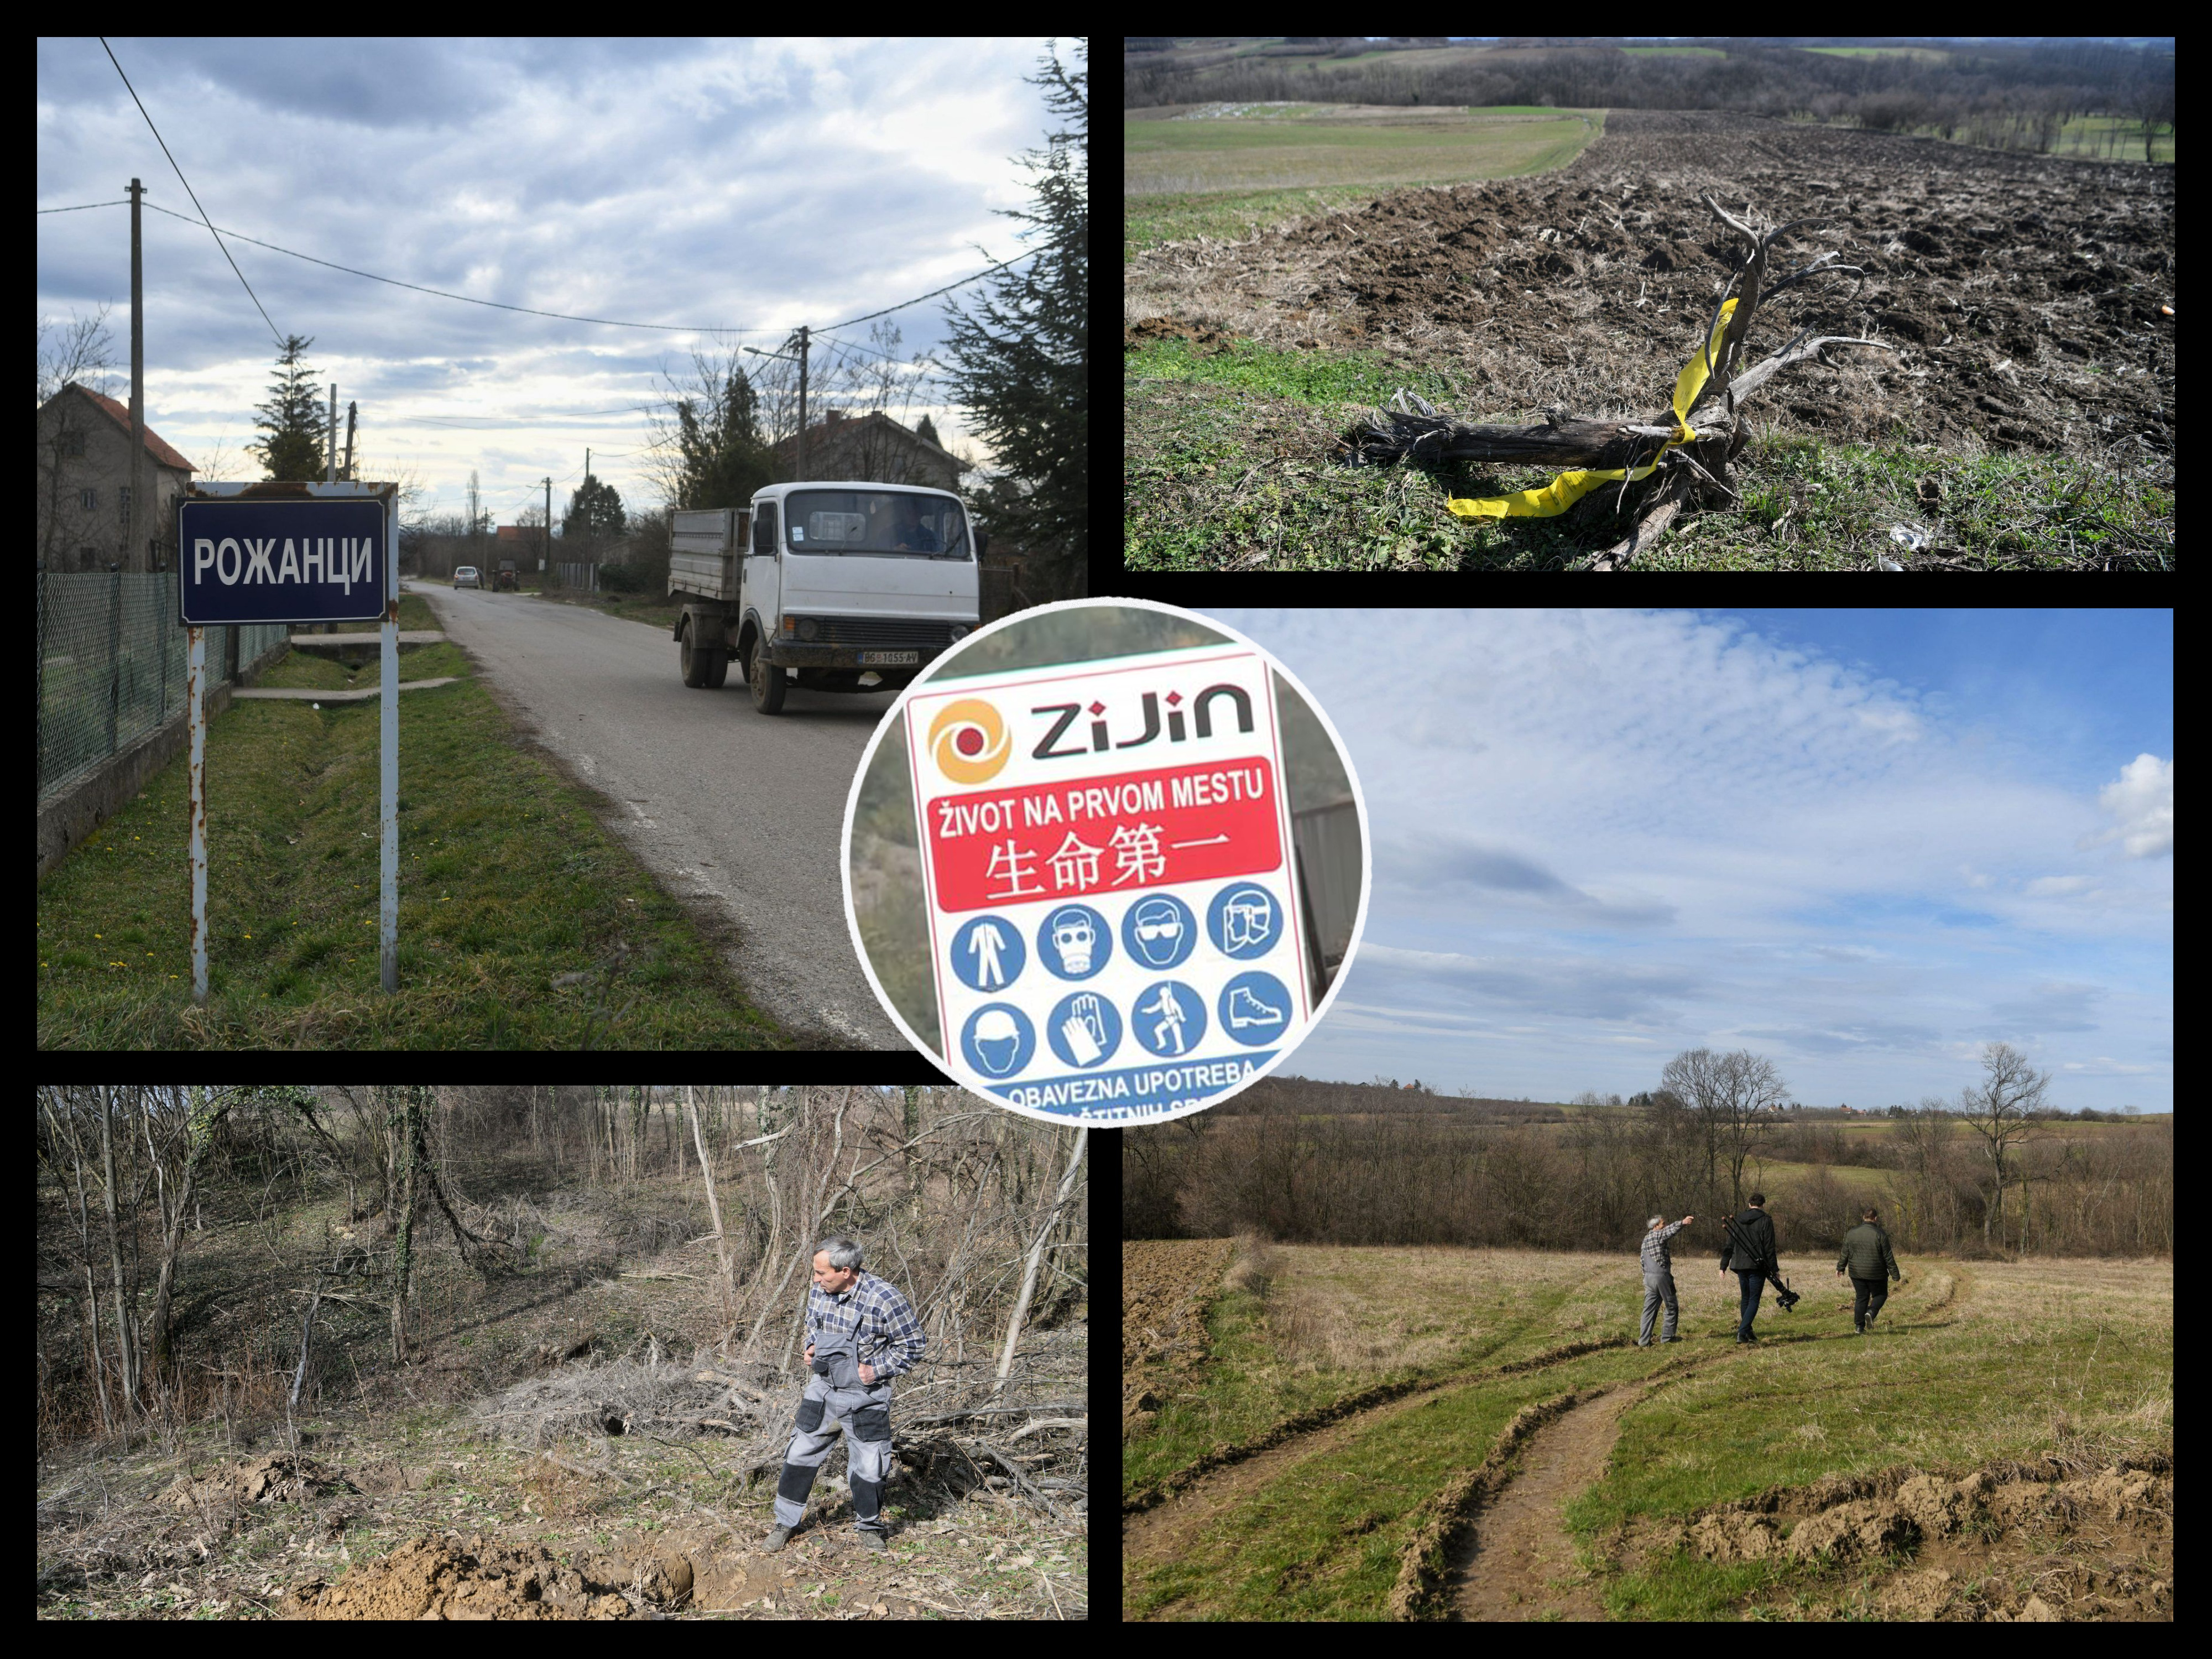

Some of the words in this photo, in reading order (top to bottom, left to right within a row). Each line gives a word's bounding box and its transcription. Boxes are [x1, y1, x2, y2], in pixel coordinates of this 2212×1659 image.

[194, 537, 372, 596] РОЖАНЦИ
[864, 653, 877, 663] BG
[938, 800, 1016, 839] ŽIVOT
[1022, 793, 1063, 827] NA
[1067, 780, 1165, 822] PRVOM
[1170, 767, 1264, 809] MESTU
[985, 821, 1231, 900] 生命第一
[1008, 1076, 1130, 1108] OBAVEZNA
[1134, 1059, 1255, 1095] UPOTREBA
